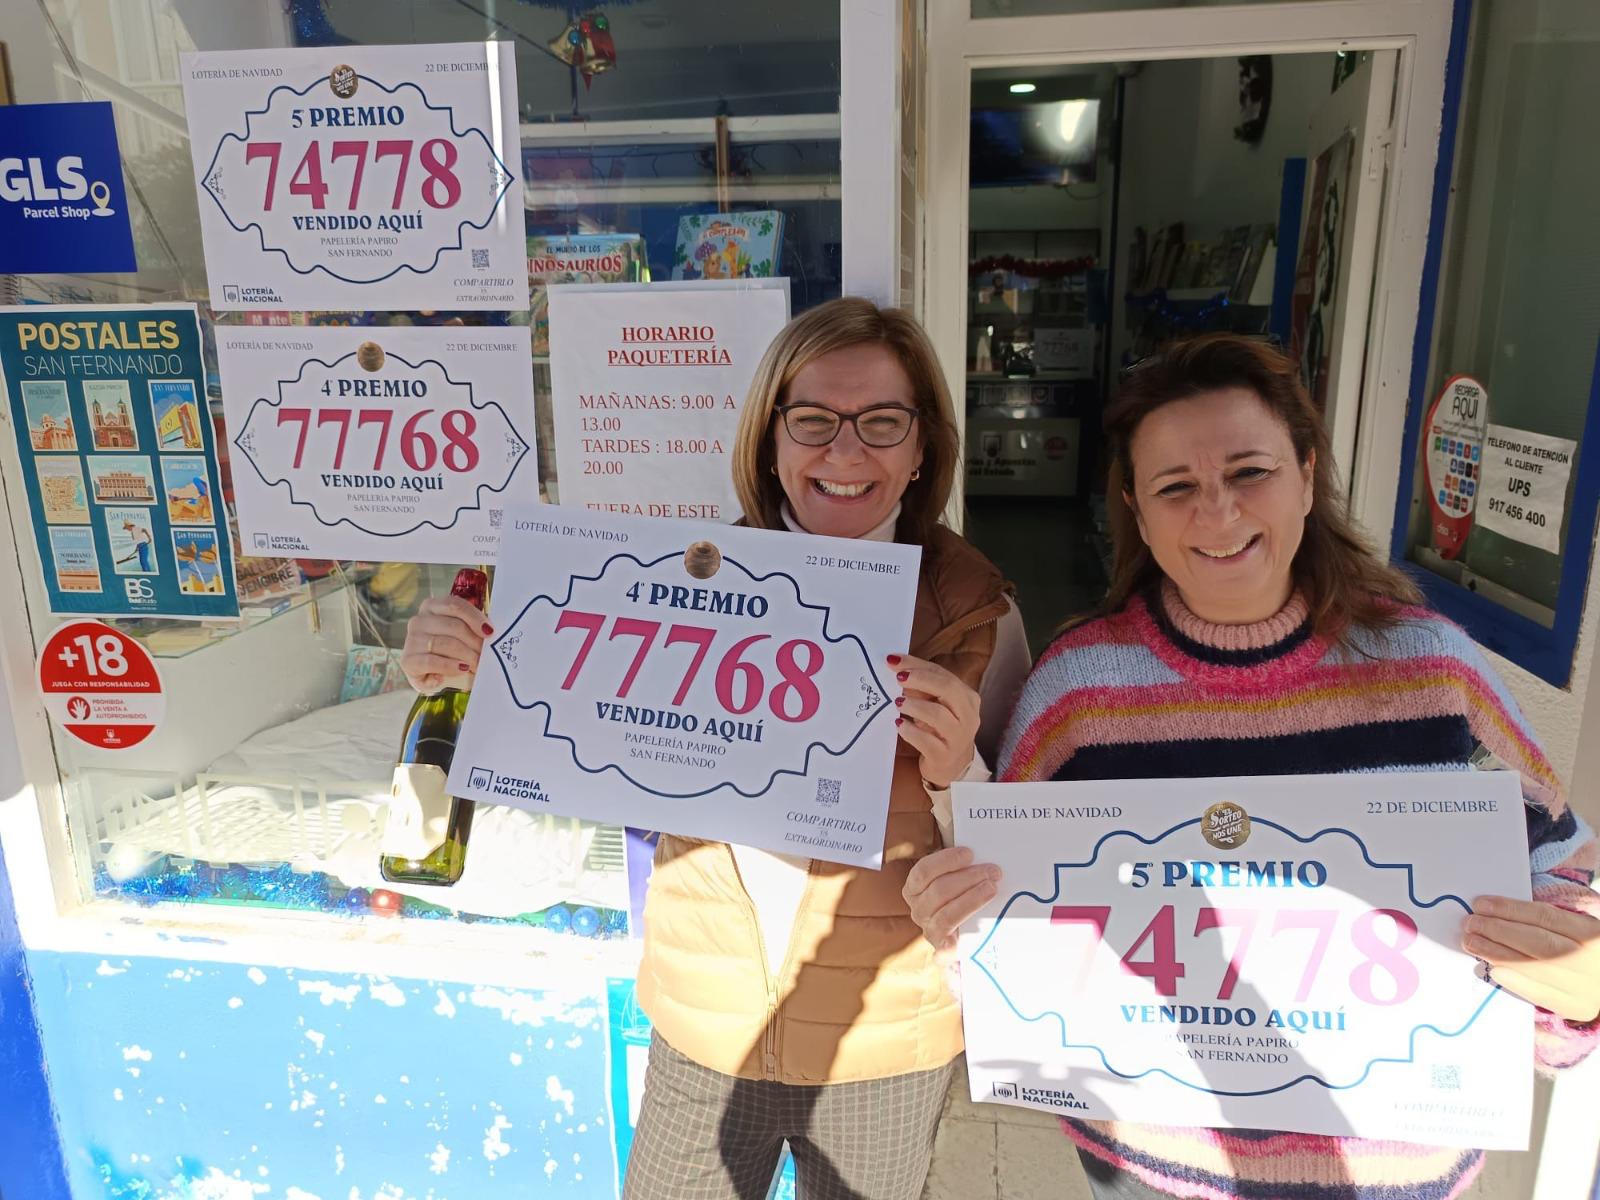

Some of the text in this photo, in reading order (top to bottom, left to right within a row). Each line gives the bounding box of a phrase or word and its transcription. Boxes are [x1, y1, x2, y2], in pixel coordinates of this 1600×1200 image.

[192, 67, 283, 80] LOTERÍA DE NAVIDAD
[425, 62, 500, 73] 22 DE DICIEMB
[310, 105, 405, 127] PREMIO
[0, 156, 88, 203] GLS
[245, 138, 462, 212] 74778
[23, 206, 91, 222] Parcel Shop
[292, 210, 423, 233] VENDIDO AQUÍ
[320, 235, 399, 246] PAPELERÍA PAPIRO
[546, 246, 555, 254] EL
[589, 245, 601, 253] LOS
[328, 248, 393, 258] SAN FERNANDO
[526, 254, 623, 274] INOSAURIOS
[241, 286, 274, 296] LOTERÍA
[242, 295, 284, 304] NACIONAL
[18, 320, 180, 351] POSTALES
[622, 326, 715, 343] HORARIO
[262, 342, 274, 350] DE
[275, 342, 314, 351] NAVIDAD
[446, 343, 519, 352] 22 DE DICIEMBRE
[24, 354, 183, 376] SAN FERNANDO
[607, 346, 733, 367] PAQUETERÍA
[338, 379, 428, 398] PREMIO
[579, 392, 736, 410] MAÑANAS: 9.00 A
[581, 417, 621, 431] 13.00
[277, 408, 480, 473] 77768
[582, 439, 651, 454] TARDES
[666, 439, 707, 454] 18.00
[711, 439, 725, 454] A
[1522, 444, 1532, 455] DE
[583, 460, 624, 475] 20.00
[1504, 456, 1544, 475] AL CLIENTE
[321, 473, 444, 493] VENDIDO AQUÍ
[1508, 476, 1532, 497] UPS
[391, 495, 421, 504] PAPIRO
[353, 504, 416, 514] SAN FERNANDO
[649, 504, 673, 518] DE
[678, 504, 721, 519] ESTE
[1488, 497, 1546, 528] 917 456 400
[271, 534, 302, 544] LOTERÍA
[515, 520, 630, 543] LOTERÍA DE NAVIDAD
[271, 542, 310, 551] NACIONAL
[805, 555, 902, 575] 22 DE DICIEMBRE
[124, 577, 154, 599] BS
[651, 583, 769, 619] PREMIO
[58, 634, 129, 677] +18
[553, 609, 826, 723] 77768
[596, 701, 765, 744] VENDIDO AQUÍ
[624, 731, 727, 756] PAPELERÍA PAPIRO
[630, 748, 717, 770] SAN FERNANDO
[495, 774, 541, 792] LOTERÍA
[493, 784, 551, 804] NACIONAL
[968, 804, 1123, 821] LOTERÍA DE NAVIDAD
[1366, 799, 1499, 815] 22 DE DICIEMBRE
[786, 810, 867, 835] COMPARTIRLO
[1210, 810, 1242, 828] SORTEO
[1212, 823, 1242, 841] NOS UNE
[783, 832, 863, 854] EXTRAORDINARIO
[1162, 860, 1328, 889] PREMIO
[1049, 904, 1420, 1007] 74778
[1120, 1004, 1347, 1032] VENDIDO AQUÍ
[1168, 1032, 1300, 1050] APELERÍA PAPIRO
[1206, 1050, 1289, 1066] FERNANDO
[1022, 1085, 1076, 1102] LOTERÍA
[1022, 1095, 1090, 1110] NACIONAL
